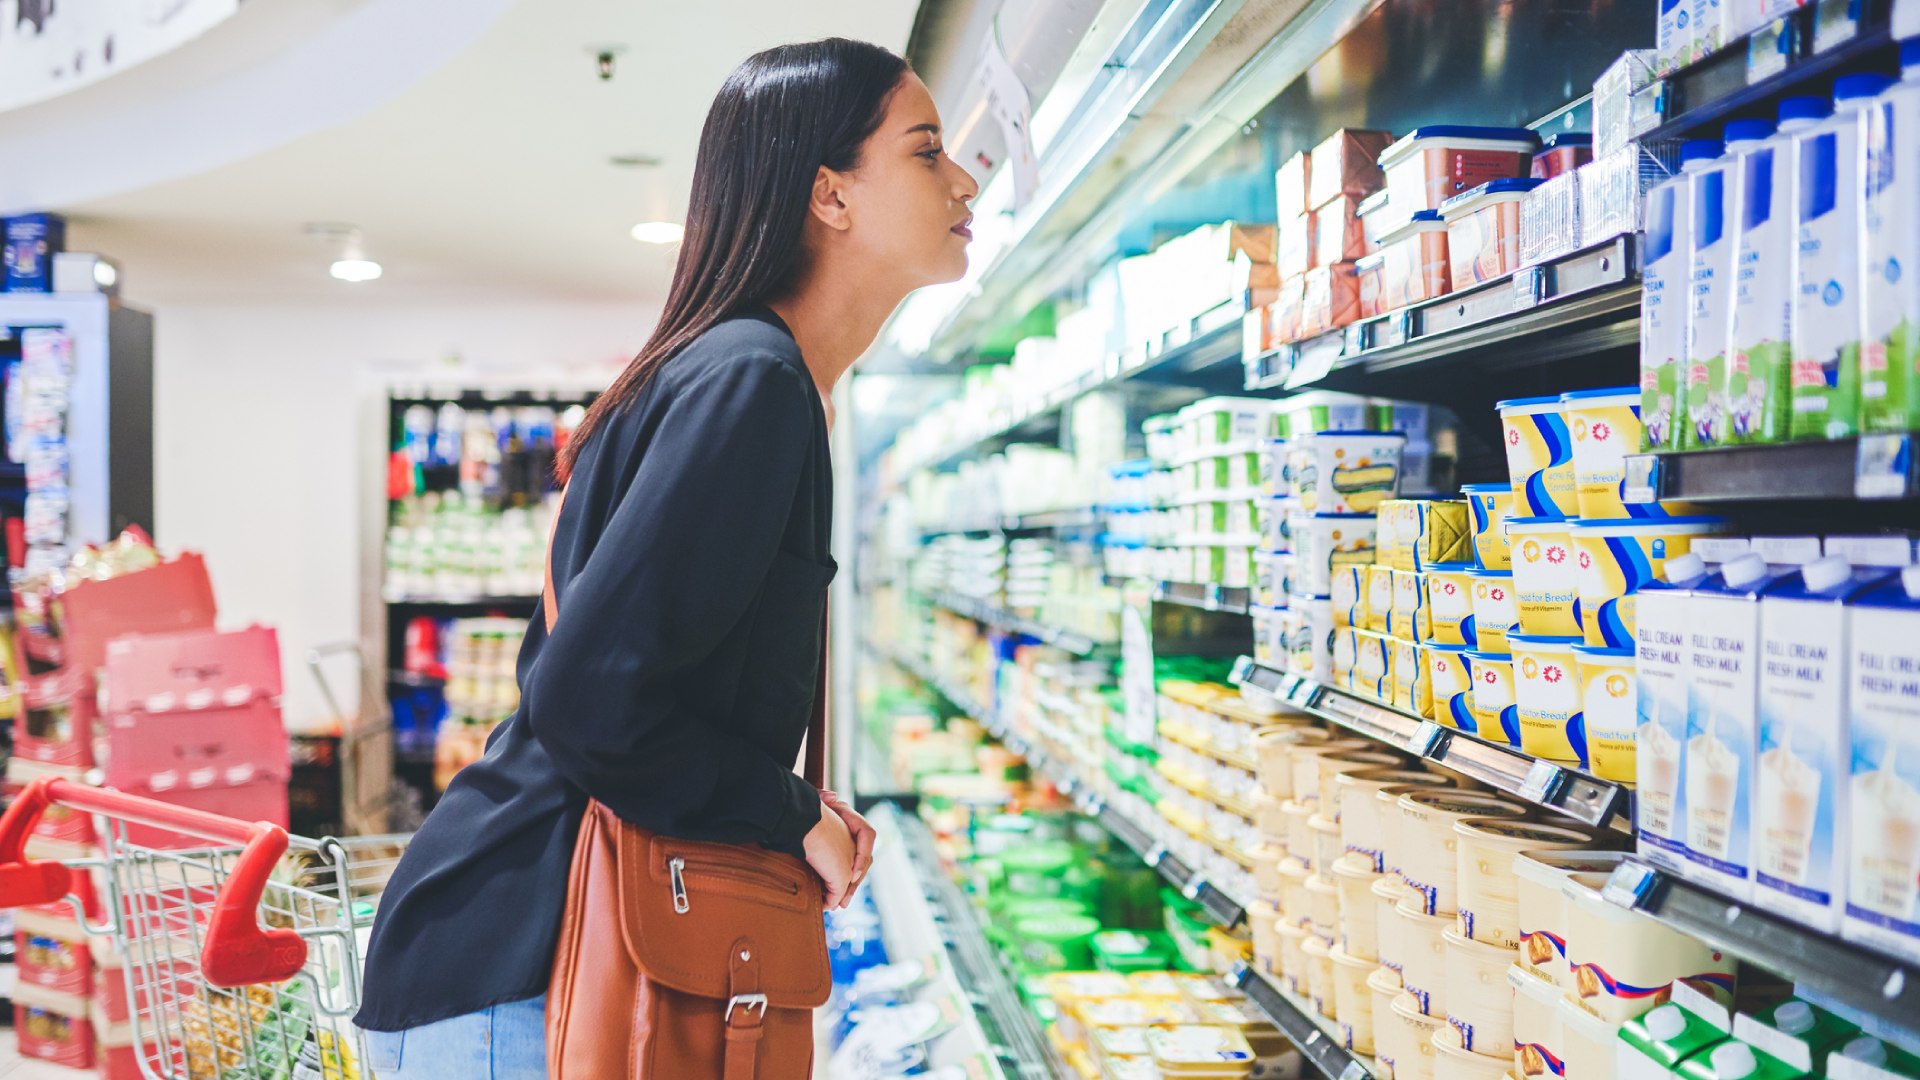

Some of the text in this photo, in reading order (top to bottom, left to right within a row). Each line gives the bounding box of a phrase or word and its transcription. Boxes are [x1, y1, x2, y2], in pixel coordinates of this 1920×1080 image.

[1592, 472, 1619, 484] Bread
[1544, 592, 1573, 603] Bread
[1489, 621, 1509, 630] Bread
[1639, 628, 1684, 647] FULL CREAM
[1692, 633, 1745, 654] FULL CREAM
[1640, 646, 1681, 665] FRESH MILK
[1766, 640, 1828, 661] FULL CREAM
[1692, 653, 1742, 674] FRESH MILK
[1766, 660, 1824, 683] FRESH MILK
[1860, 651, 1920, 676] FULL CREA
[1860, 674, 1896, 694] FRESH
[1540, 710, 1568, 720] Bread
[1615, 730, 1630, 741] for
[1651, 815, 1668, 832] Litres
[1703, 834, 1723, 851] Litres
[1505, 939, 1520, 951] 1 kg
